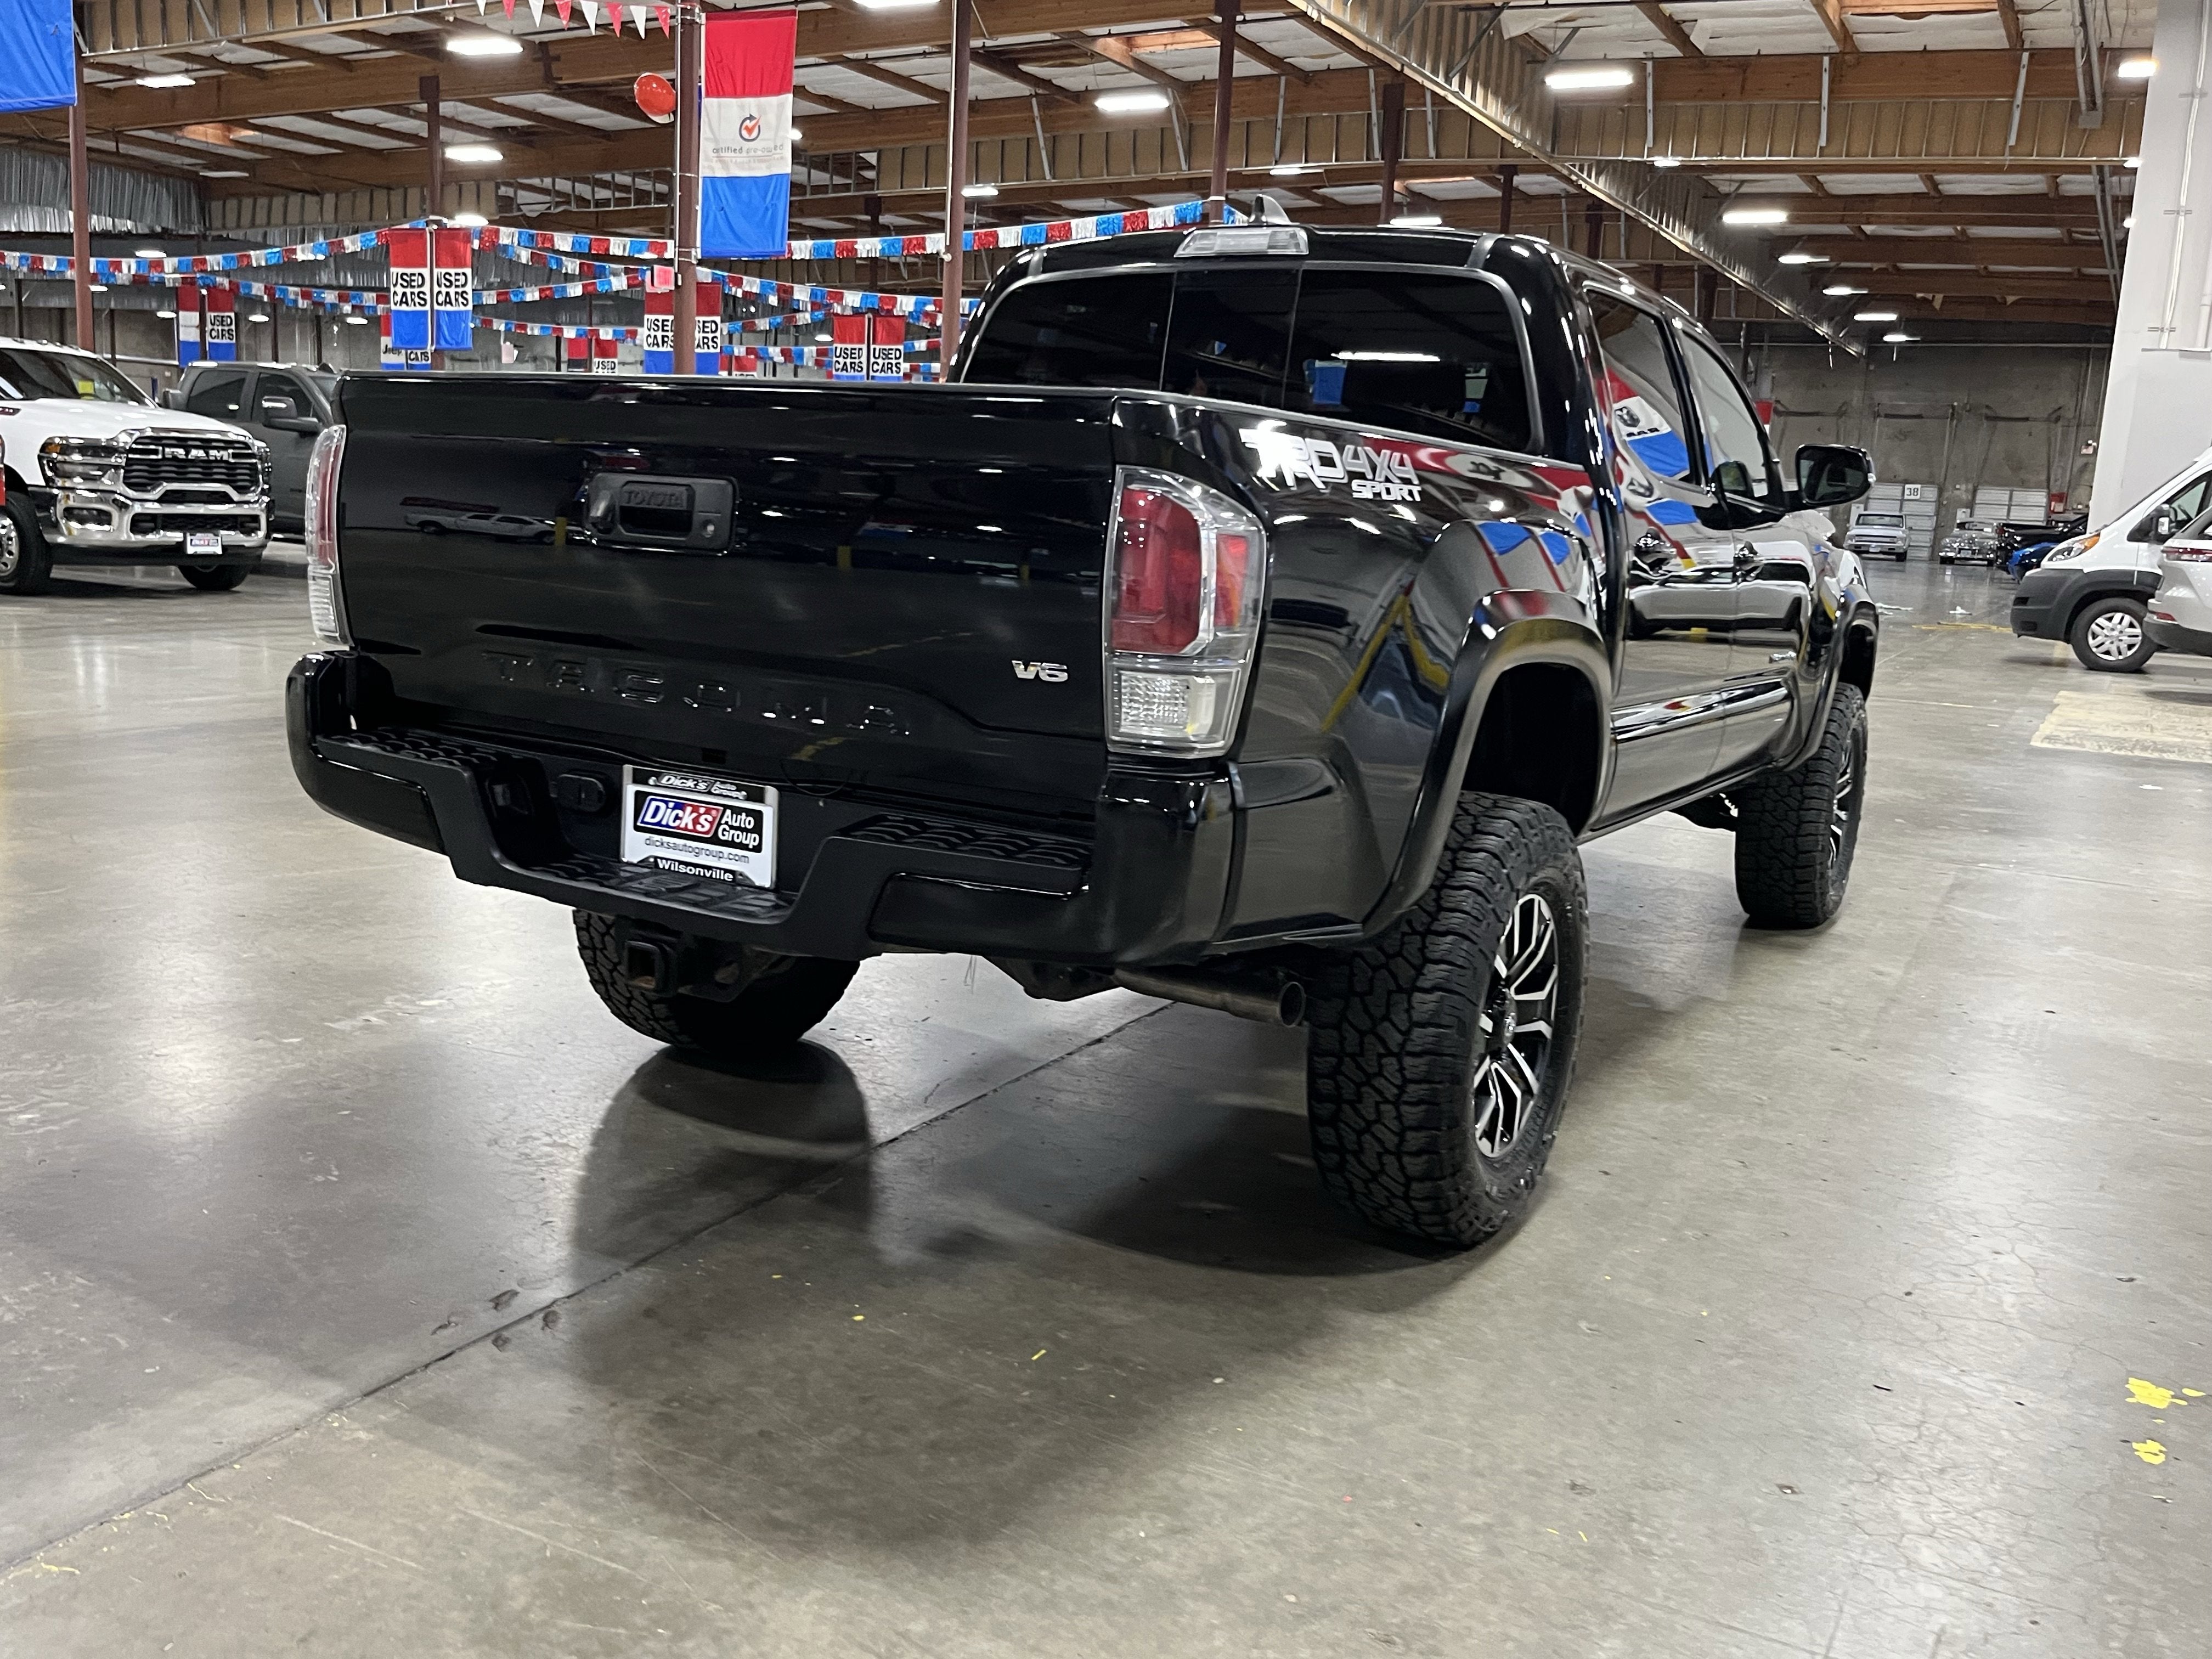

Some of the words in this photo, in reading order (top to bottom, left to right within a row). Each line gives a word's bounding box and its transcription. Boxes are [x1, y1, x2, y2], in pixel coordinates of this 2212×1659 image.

[392, 272, 426, 289] USED
[436, 272, 468, 289] USED
[392, 290, 427, 307] CARS
[436, 290, 469, 307] CARS
[210, 315, 233, 327] USED
[696, 336, 719, 349] ARS
[834, 346, 863, 360] USED
[873, 347, 902, 360] USED
[834, 360, 864, 373] CARS
[871, 361, 901, 374] CARS
[165, 447, 229, 460] RAM
[1351, 479, 1422, 501] SPORT
[1906, 487, 1919, 496] 38
[1011, 660, 1069, 682] V6
[483, 650, 910, 736] TACOMA
[661, 775, 708, 790] Dick's
[643, 800, 714, 833] Dick's
[721, 809, 754, 829] Auto
[718, 825, 760, 849] Group
[645, 836, 750, 864] dicksautogroup.com
[657, 858, 734, 882] Wilsonville
